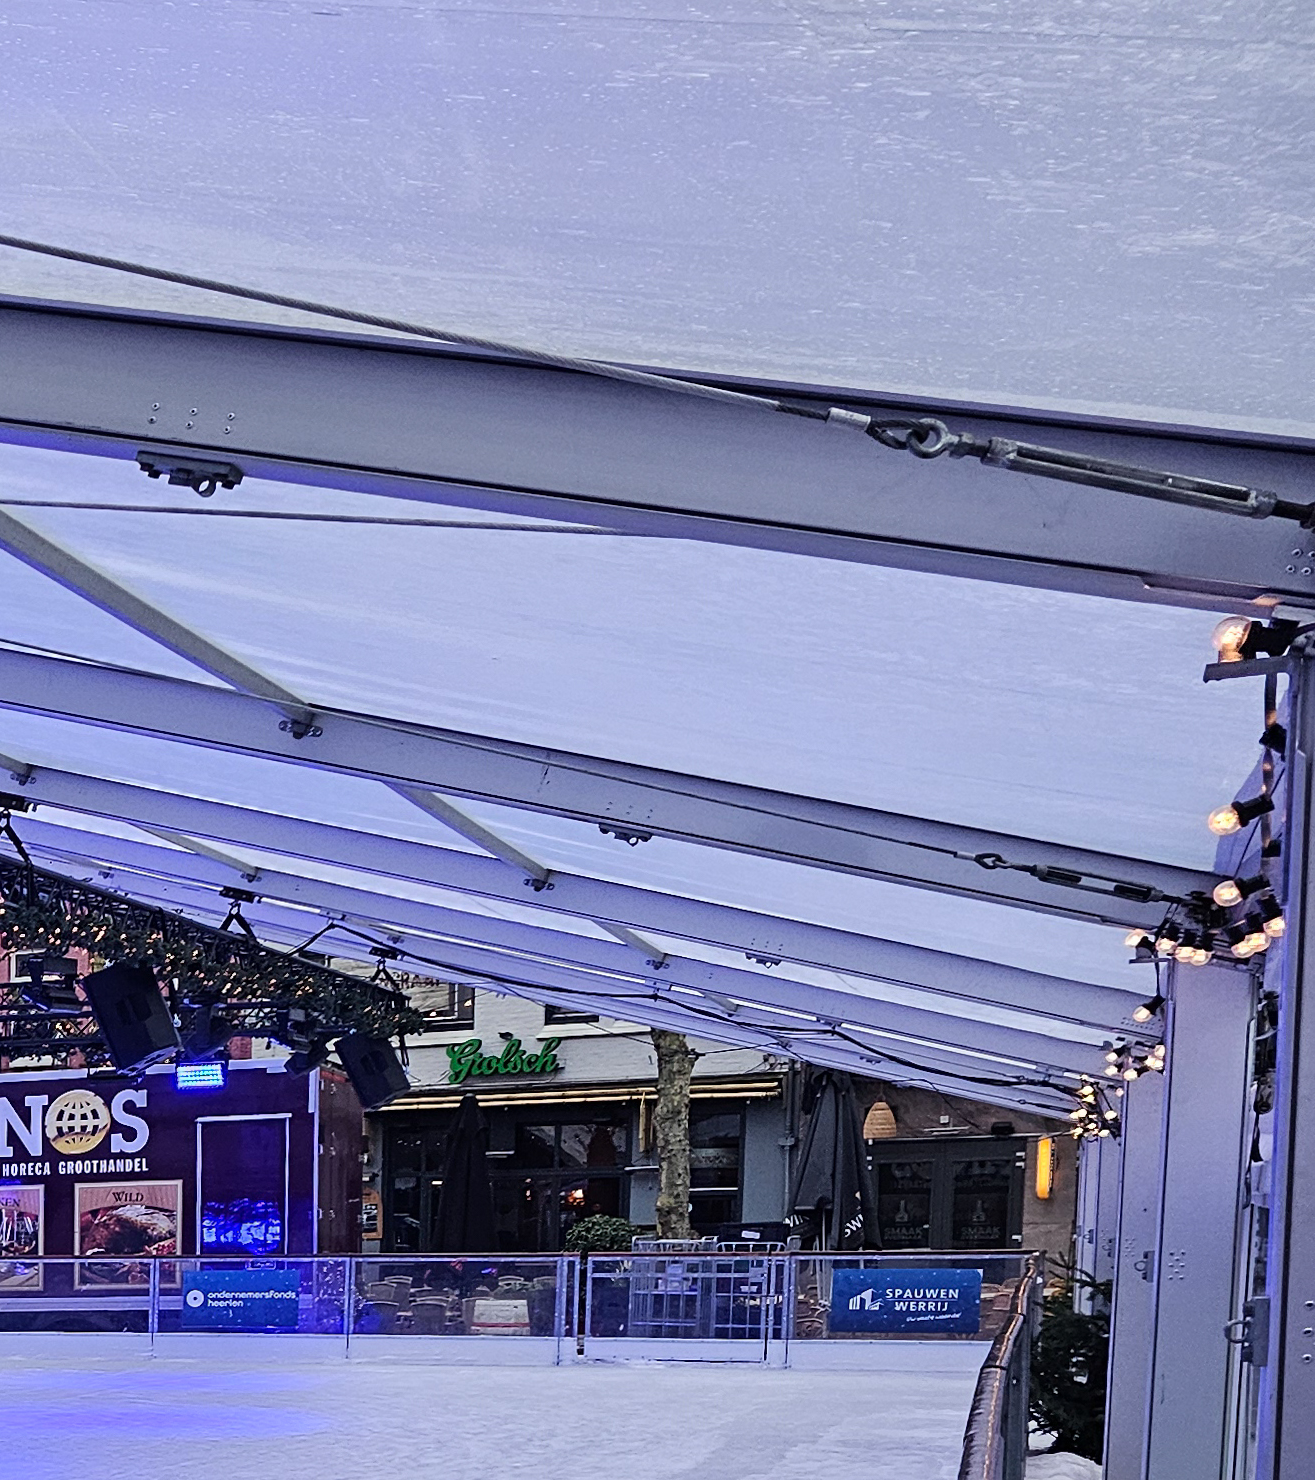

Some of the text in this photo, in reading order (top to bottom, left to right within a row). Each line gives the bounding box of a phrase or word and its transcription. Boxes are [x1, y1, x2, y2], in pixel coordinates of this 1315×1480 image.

[446, 1037, 559, 1084] Grolsch
[2, 1161, 51, 1177] HORECA
[58, 1158, 149, 1175] GROOTHANDEL
[111, 1190, 144, 1203] WILD
[207, 1290, 296, 1299] ondernemersfonds
[885, 1288, 959, 1299] SPAUWEN
[207, 1299, 244, 1307] heerlen
[895, 1302, 948, 1311] WERRIJ
